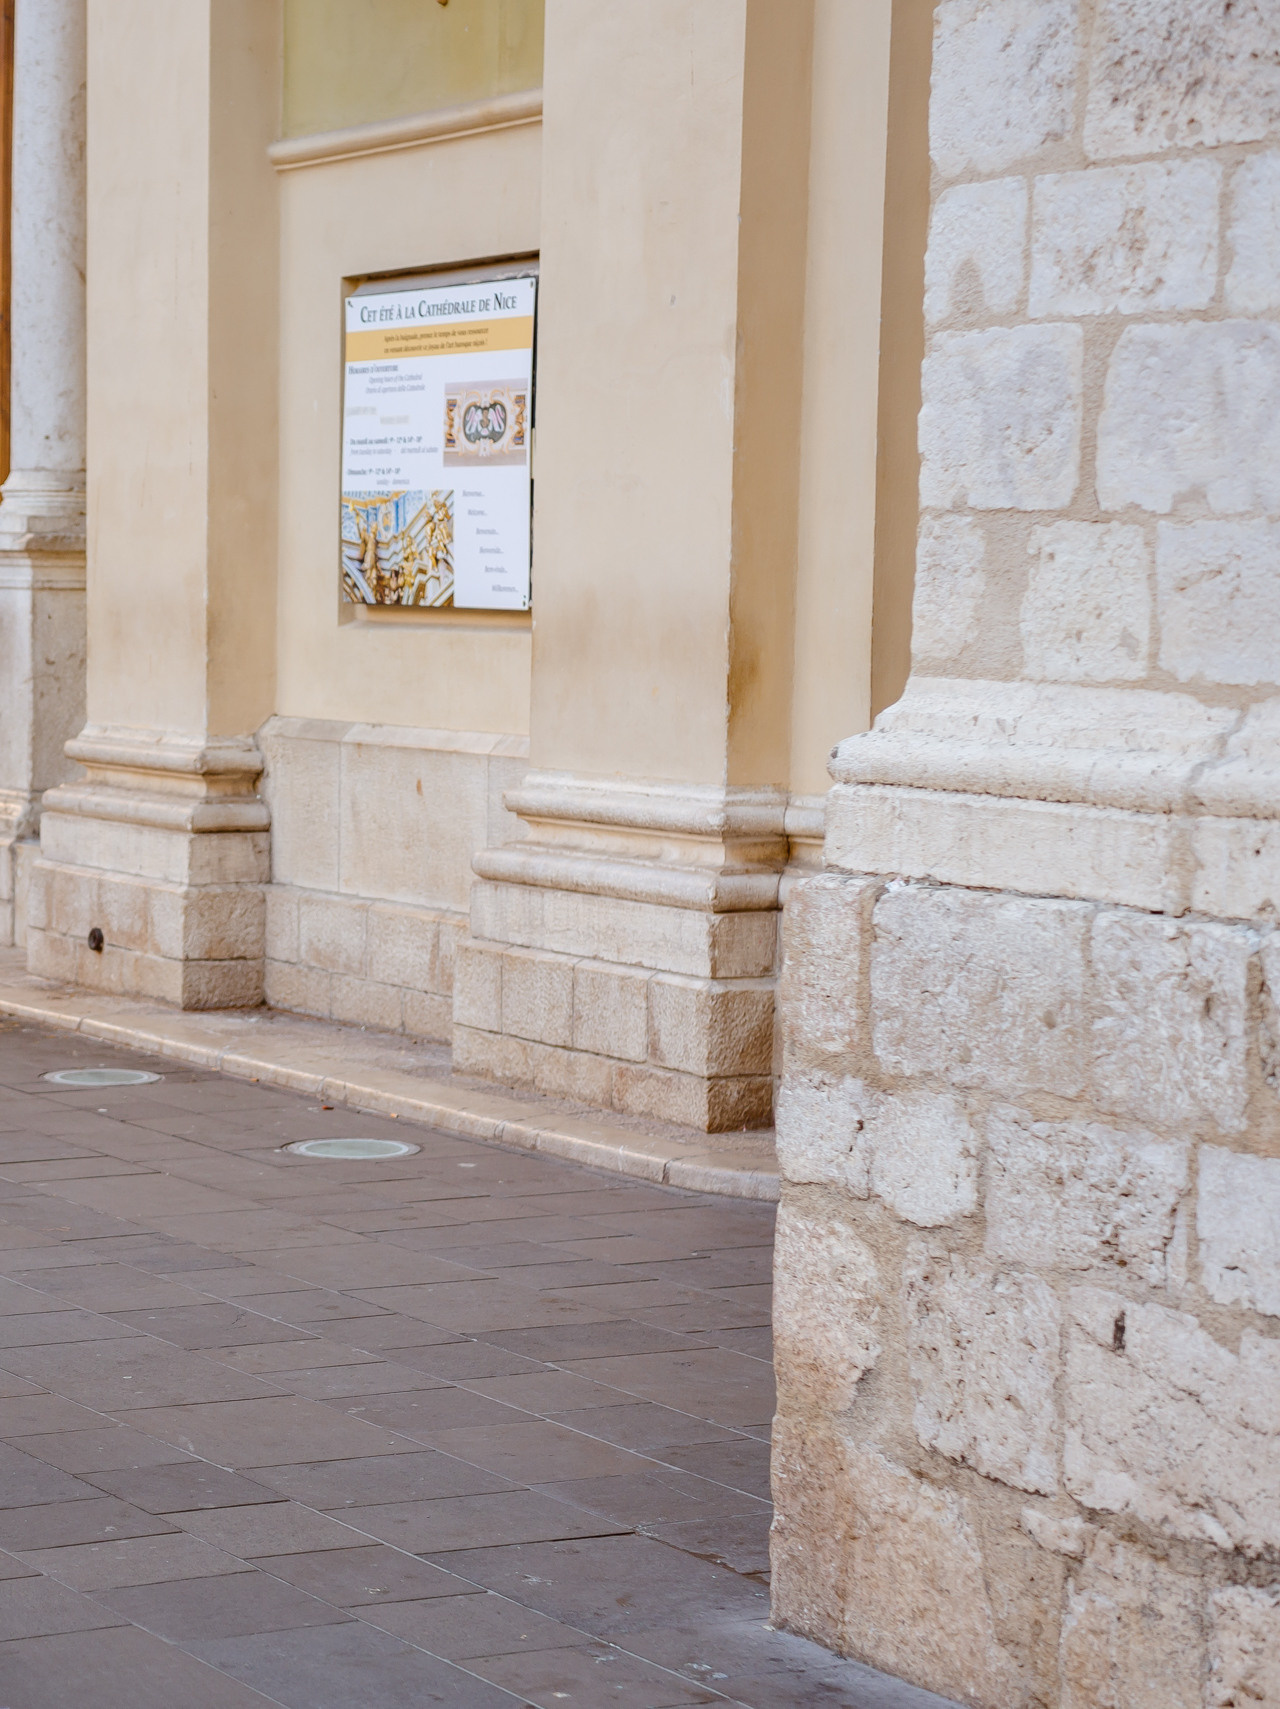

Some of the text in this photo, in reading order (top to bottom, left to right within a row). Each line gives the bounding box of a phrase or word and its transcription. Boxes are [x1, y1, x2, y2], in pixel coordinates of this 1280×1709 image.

[360, 292, 517, 323] CET ÉTÉ À LA CATHÉDRALE DE NICE
